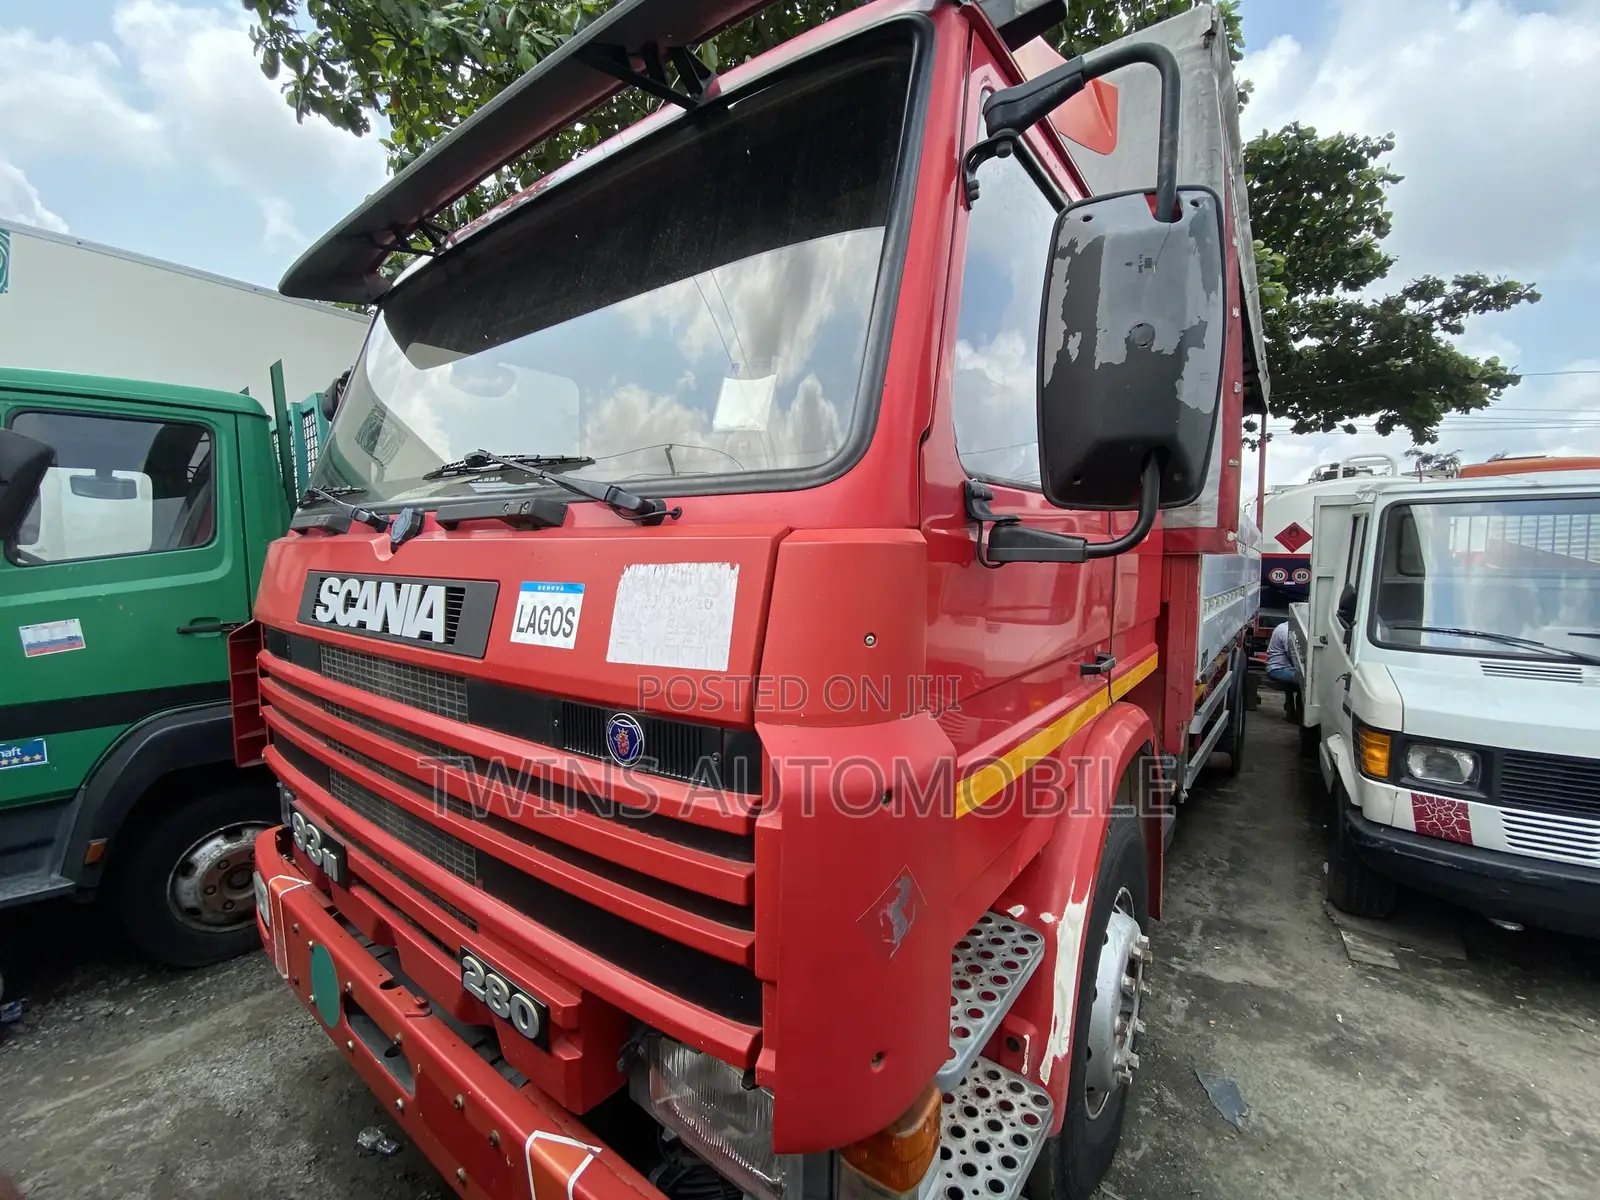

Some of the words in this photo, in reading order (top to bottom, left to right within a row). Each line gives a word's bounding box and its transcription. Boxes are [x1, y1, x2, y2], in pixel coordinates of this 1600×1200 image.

[315, 576, 447, 643] SCANIA
[537, 584, 565, 592] GENOVA
[516, 603, 577, 638] LAGOS
[462, 955, 540, 1040] 280
